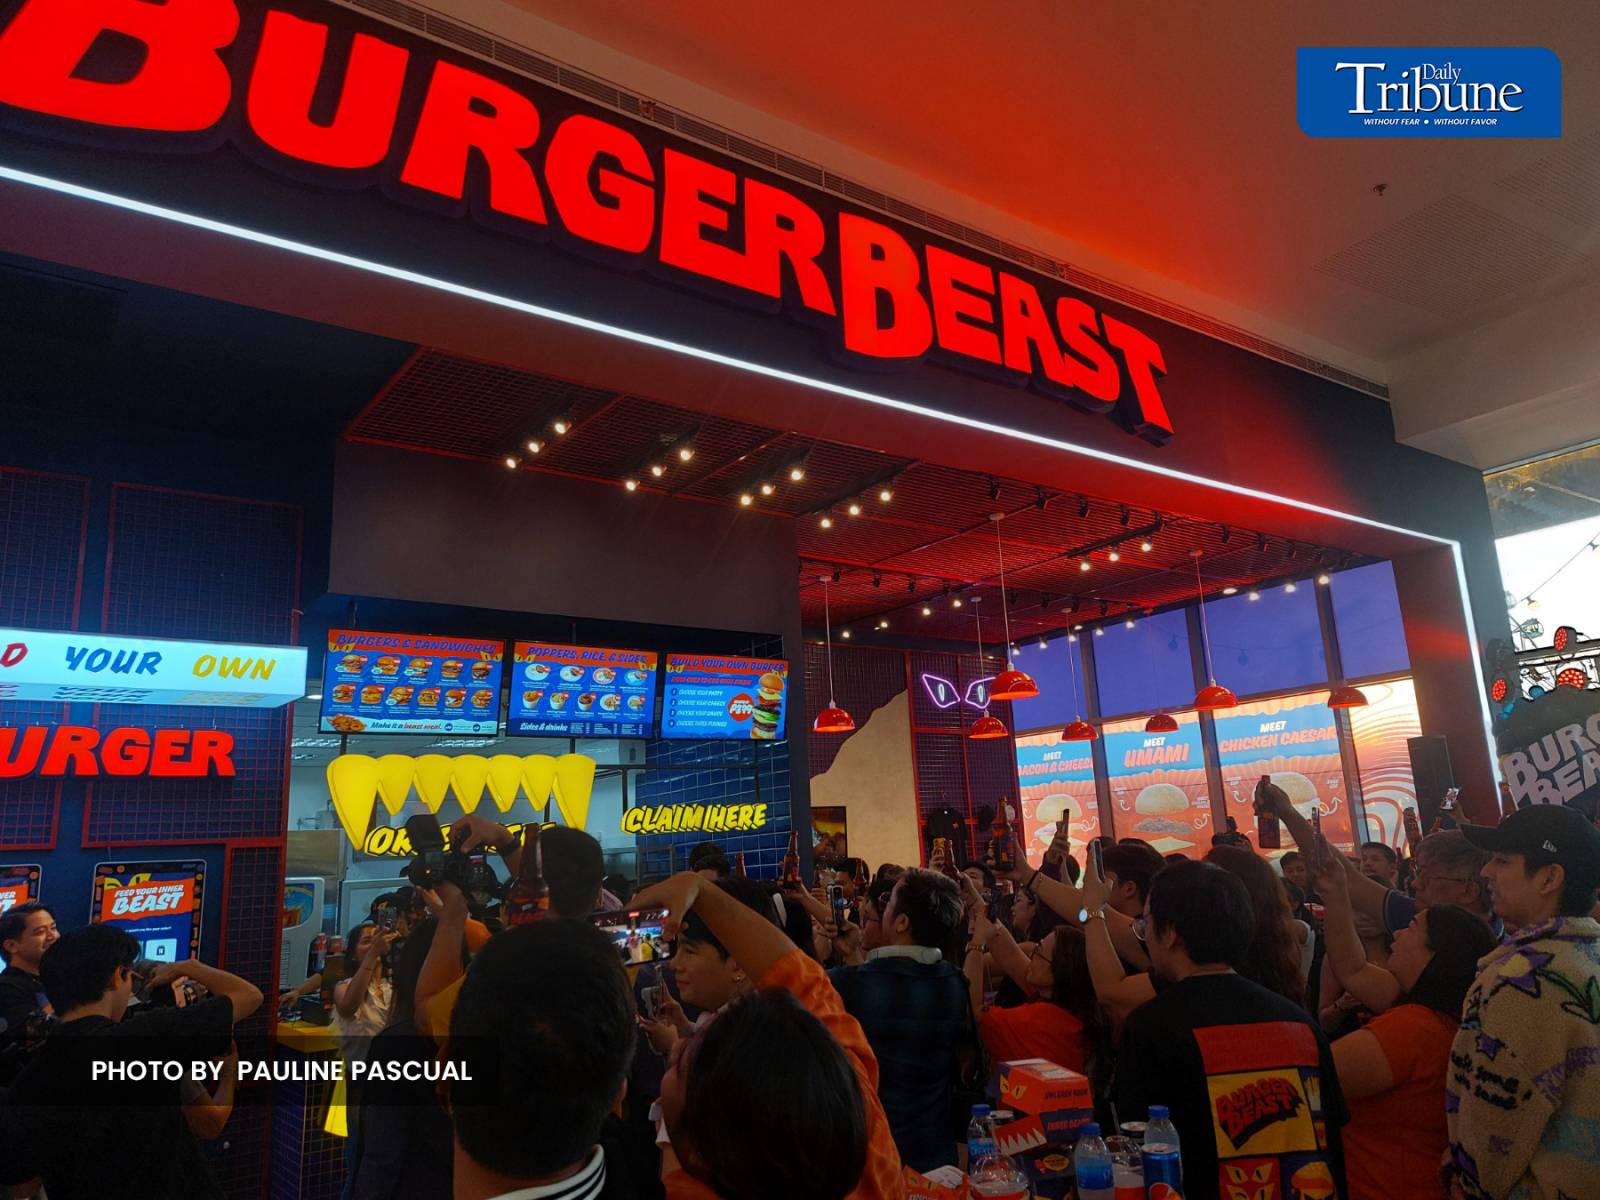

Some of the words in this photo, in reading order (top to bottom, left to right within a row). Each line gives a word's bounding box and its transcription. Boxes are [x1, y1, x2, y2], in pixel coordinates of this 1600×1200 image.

[0, 0, 836, 317] BURGER
[838, 211, 1175, 435] BEAST
[336, 633, 399, 649] BURGERS
[402, 639, 411, 649] &
[413, 639, 497, 653] SANDWICHES
[65, 646, 163, 676] YOUR
[192, 654, 277, 681] OWN
[702, 659, 726, 668] YOUR
[727, 660, 749, 669] OWN
[1260, 721, 1287, 733] MEET
[0, 725, 235, 778] URGER
[1143, 736, 1166, 747] MEET
[1219, 734, 1279, 753] CHICKEN
[1043, 751, 1063, 761] MEET
[1123, 743, 1190, 768] UMAMI
[620, 803, 705, 836] CLAIM
[703, 803, 768, 833] HERE
[111, 891, 184, 915] BEAST
[114, 888, 134, 898] FEED
[135, 886, 158, 896] YOUR
[158, 884, 184, 894] INNER
[1215, 1077, 1298, 1128] BURGER
[1227, 1094, 1297, 1141] BEAST
